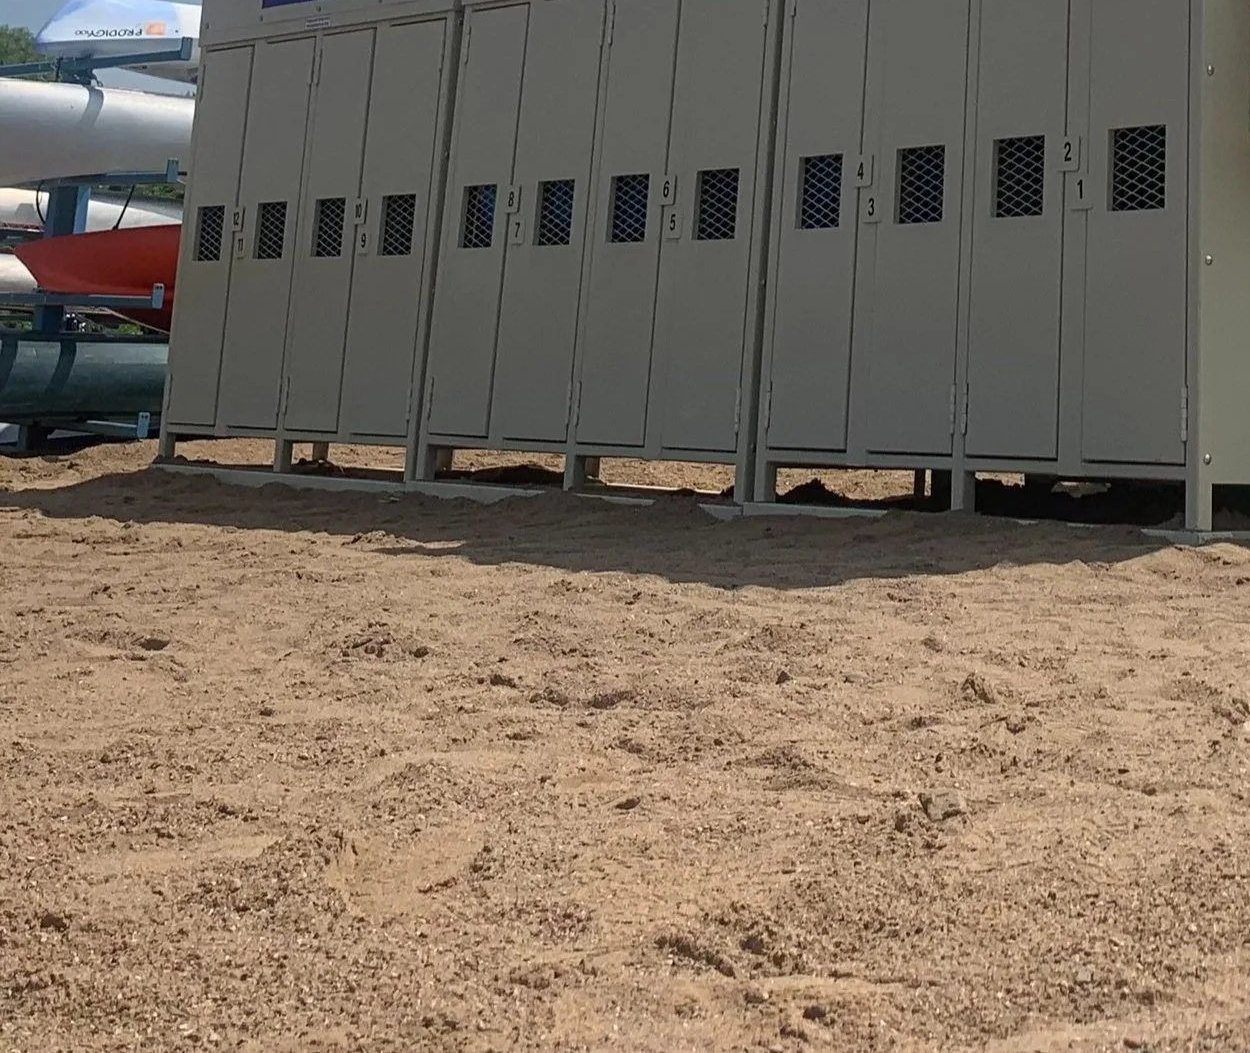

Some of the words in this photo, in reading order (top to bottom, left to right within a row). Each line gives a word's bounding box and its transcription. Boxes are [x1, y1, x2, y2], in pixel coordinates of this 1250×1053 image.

[87, 28, 143, 38] PRODIGY
[1063, 142, 1072, 162] 2
[857, 162, 864, 180] 4
[662, 181, 670, 198] 6
[1077, 179, 1083, 199] 1
[507, 191, 514, 207] 8
[868, 198, 875, 216] 3
[355, 204, 362, 218] 10
[233, 213, 240, 226] 12
[669, 214, 676, 231] 5
[514, 222, 520, 238] 7
[238, 238, 244, 252] 11
[361, 233, 367, 248] 9
